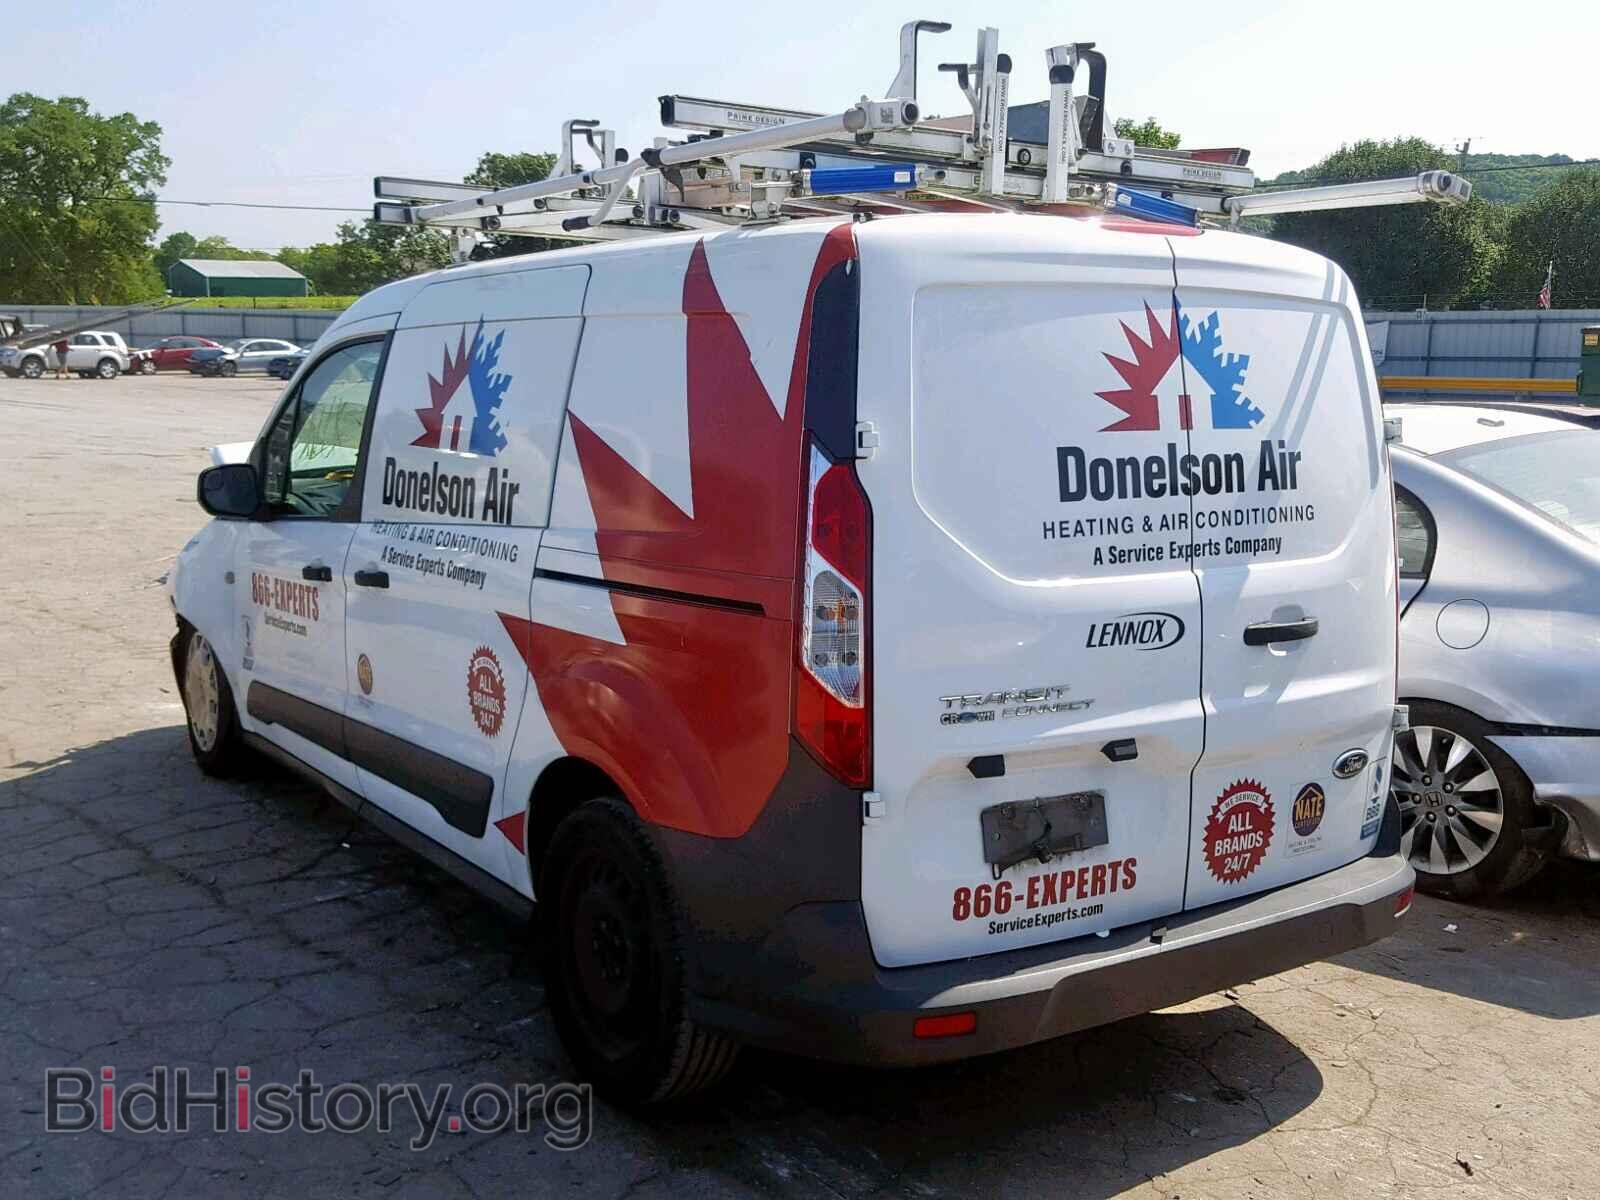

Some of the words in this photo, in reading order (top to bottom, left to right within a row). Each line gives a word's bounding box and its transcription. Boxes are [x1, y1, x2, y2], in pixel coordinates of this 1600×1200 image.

[1056, 442, 1246, 502] Donelson
[1257, 439, 1303, 492] Air
[382, 456, 476, 519] Donelson
[482, 466, 521, 525] Air
[1043, 515, 1134, 540] HEATING
[1142, 515, 1154, 533] &
[1160, 512, 1189, 531] AIR
[1195, 504, 1315, 529] CONDITIONING
[409, 525, 418, 541] &
[417, 527, 435, 545] AIR
[436, 530, 519, 563] CONDITIONING
[1093, 546, 1104, 566] A
[1108, 543, 1164, 565] Service
[1169, 538, 1221, 561] Experts
[1225, 536, 1283, 556] Company
[381, 544, 389, 562] A
[387, 546, 415, 569] Service
[416, 552, 445, 576] Experts
[447, 560, 488, 589] Company
[251, 572, 320, 622] 866-EXPERTS
[1086, 618, 1167, 649] LENNOX
[479, 673, 494, 694] ALL
[939, 683, 1071, 709] TRANSIT
[1228, 811, 1254, 834] ALL
[1294, 794, 1324, 821] NATE
[1214, 830, 1265, 857] BRANDS
[1223, 852, 1252, 875] 24/7
[952, 857, 1138, 922] 866-EXPERTS
[988, 903, 1104, 936] ServiceExperts.com
